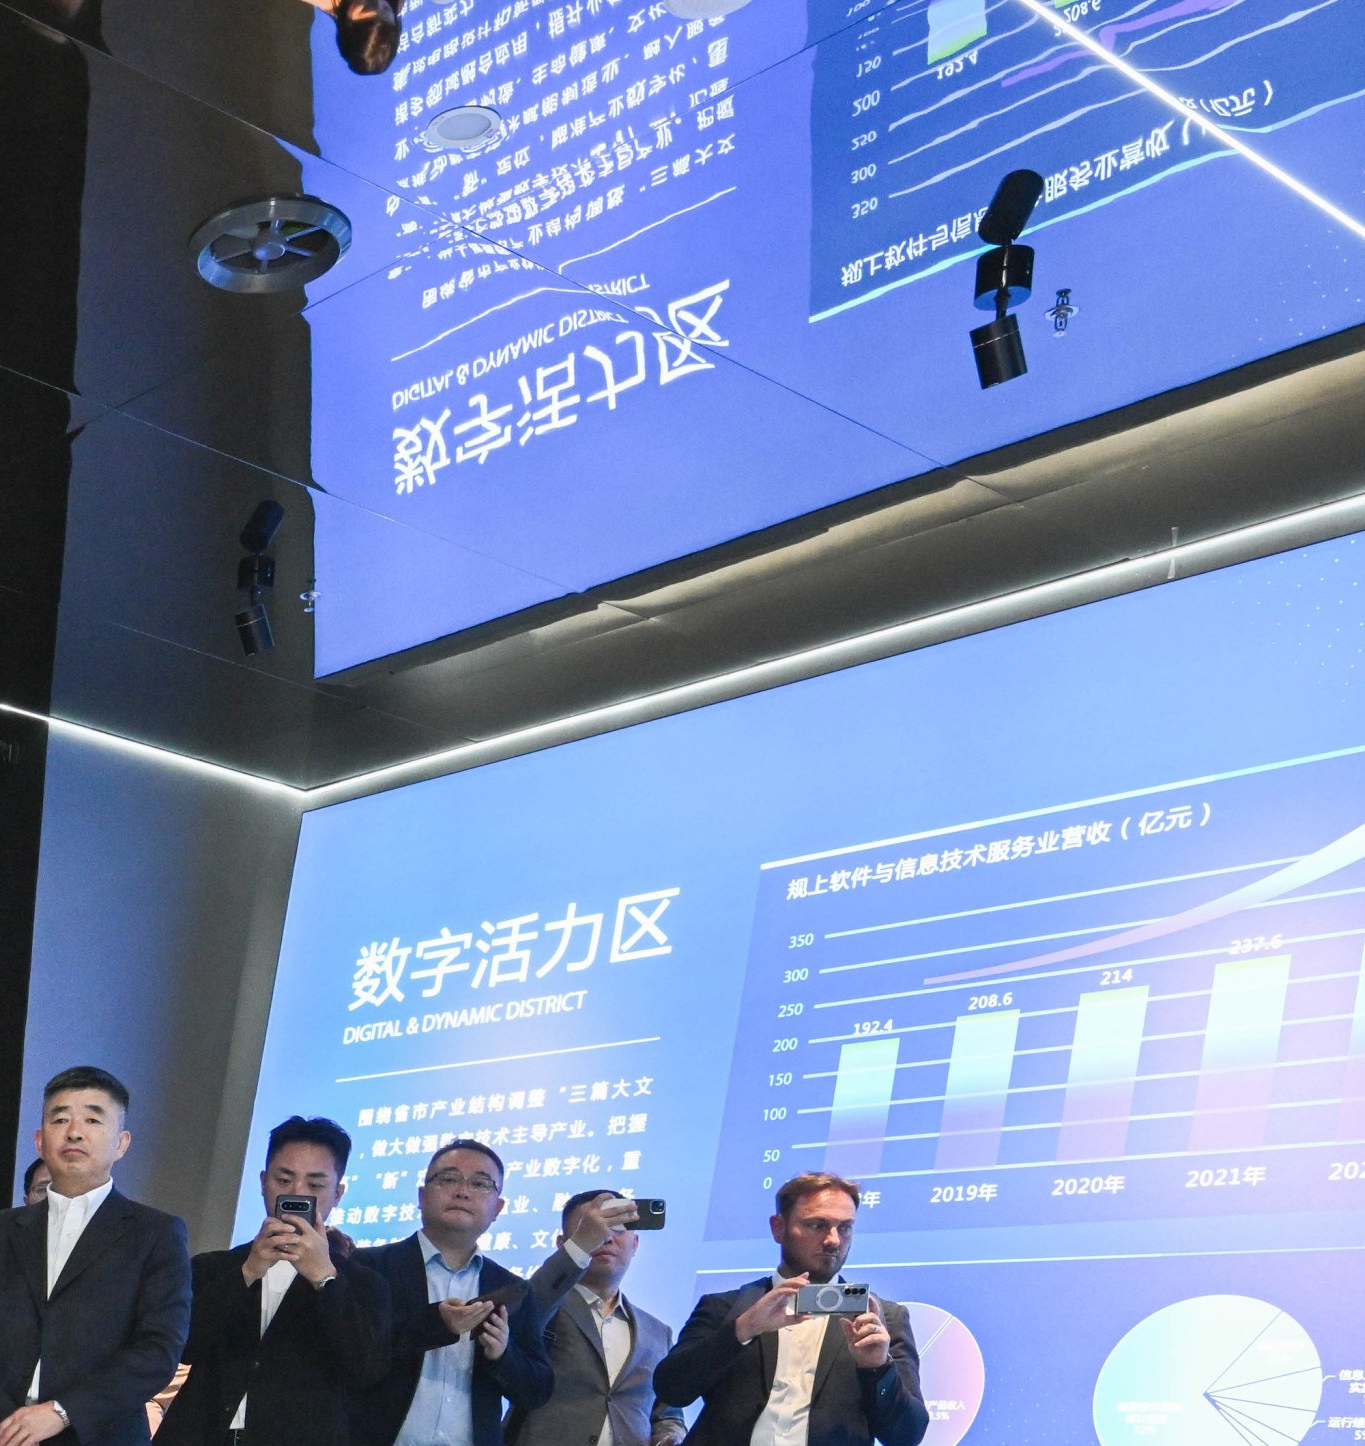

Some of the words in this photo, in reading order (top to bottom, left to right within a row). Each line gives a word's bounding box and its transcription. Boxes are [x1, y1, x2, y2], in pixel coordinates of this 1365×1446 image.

[348, 887, 680, 1011] 数字活力区
[788, 932, 814, 949] 350
[783, 968, 809, 983] 300
[1100, 968, 1134, 985] 214
[968, 992, 1013, 1010] 208.6
[343, 1017, 403, 1045] DIGITAL
[406, 1016, 419, 1035] &
[422, 1001, 502, 1033] DYNAMIC
[505, 990, 588, 1020] DISTRICT
[777, 1003, 804, 1018] 250
[853, 1019, 894, 1037] 192.4
[772, 1038, 798, 1052] 200
[768, 1072, 793, 1087] 150
[763, 1106, 787, 1121] 100
[762, 1149, 780, 1162] 50
[762, 1176, 772, 1189] 0
[1185, 1165, 1267, 1188] 2021年
[930, 1183, 998, 1203] 2019年
[1052, 1175, 1126, 1196] 2020年
